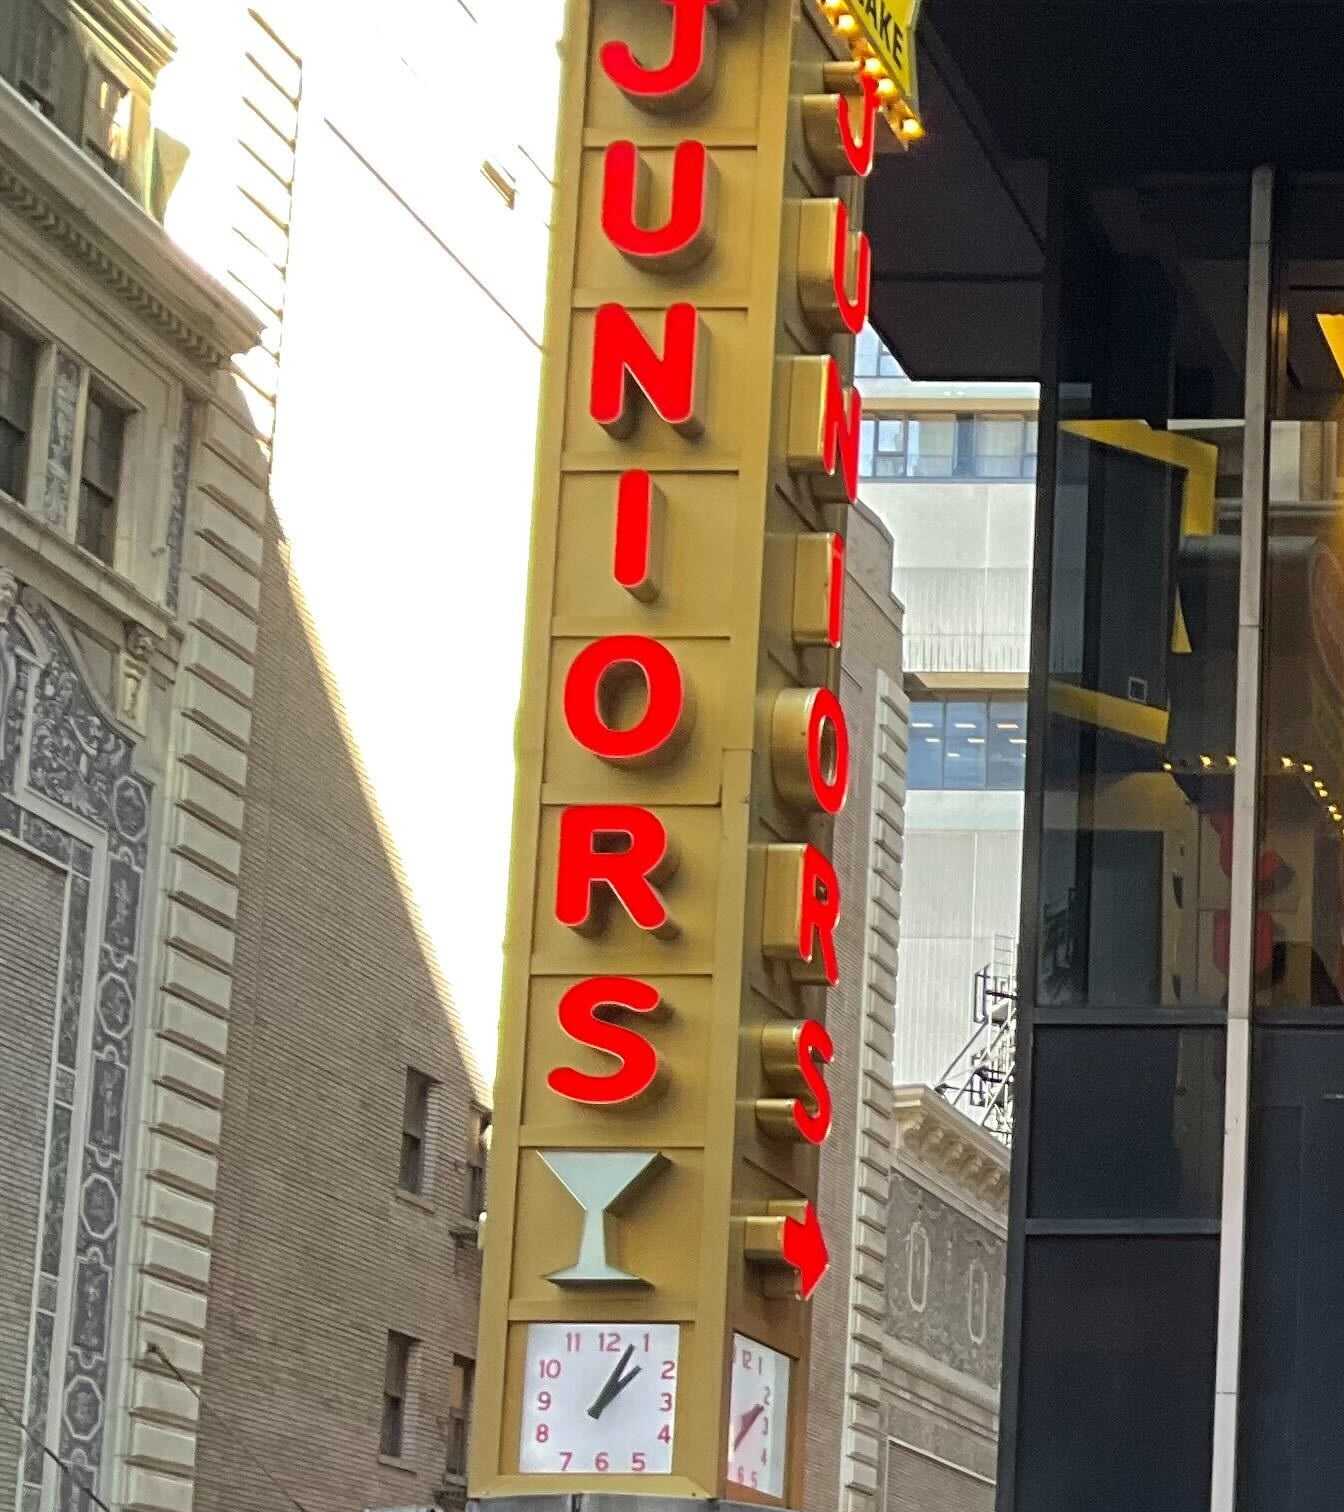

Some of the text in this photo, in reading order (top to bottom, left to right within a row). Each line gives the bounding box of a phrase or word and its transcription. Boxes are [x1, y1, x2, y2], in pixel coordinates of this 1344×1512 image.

[859, 0, 904, 70] AKE
[599, 1332, 622, 1352] 12
[539, 1359, 562, 1379] 10
[660, 1360, 676, 1381] 2
[537, 1391, 552, 1411] 9
[659, 1391, 673, 1412] 3
[535, 1423, 550, 1443] 8
[656, 1424, 672, 1444] 4
[559, 1451, 646, 1473] 7 6 5
